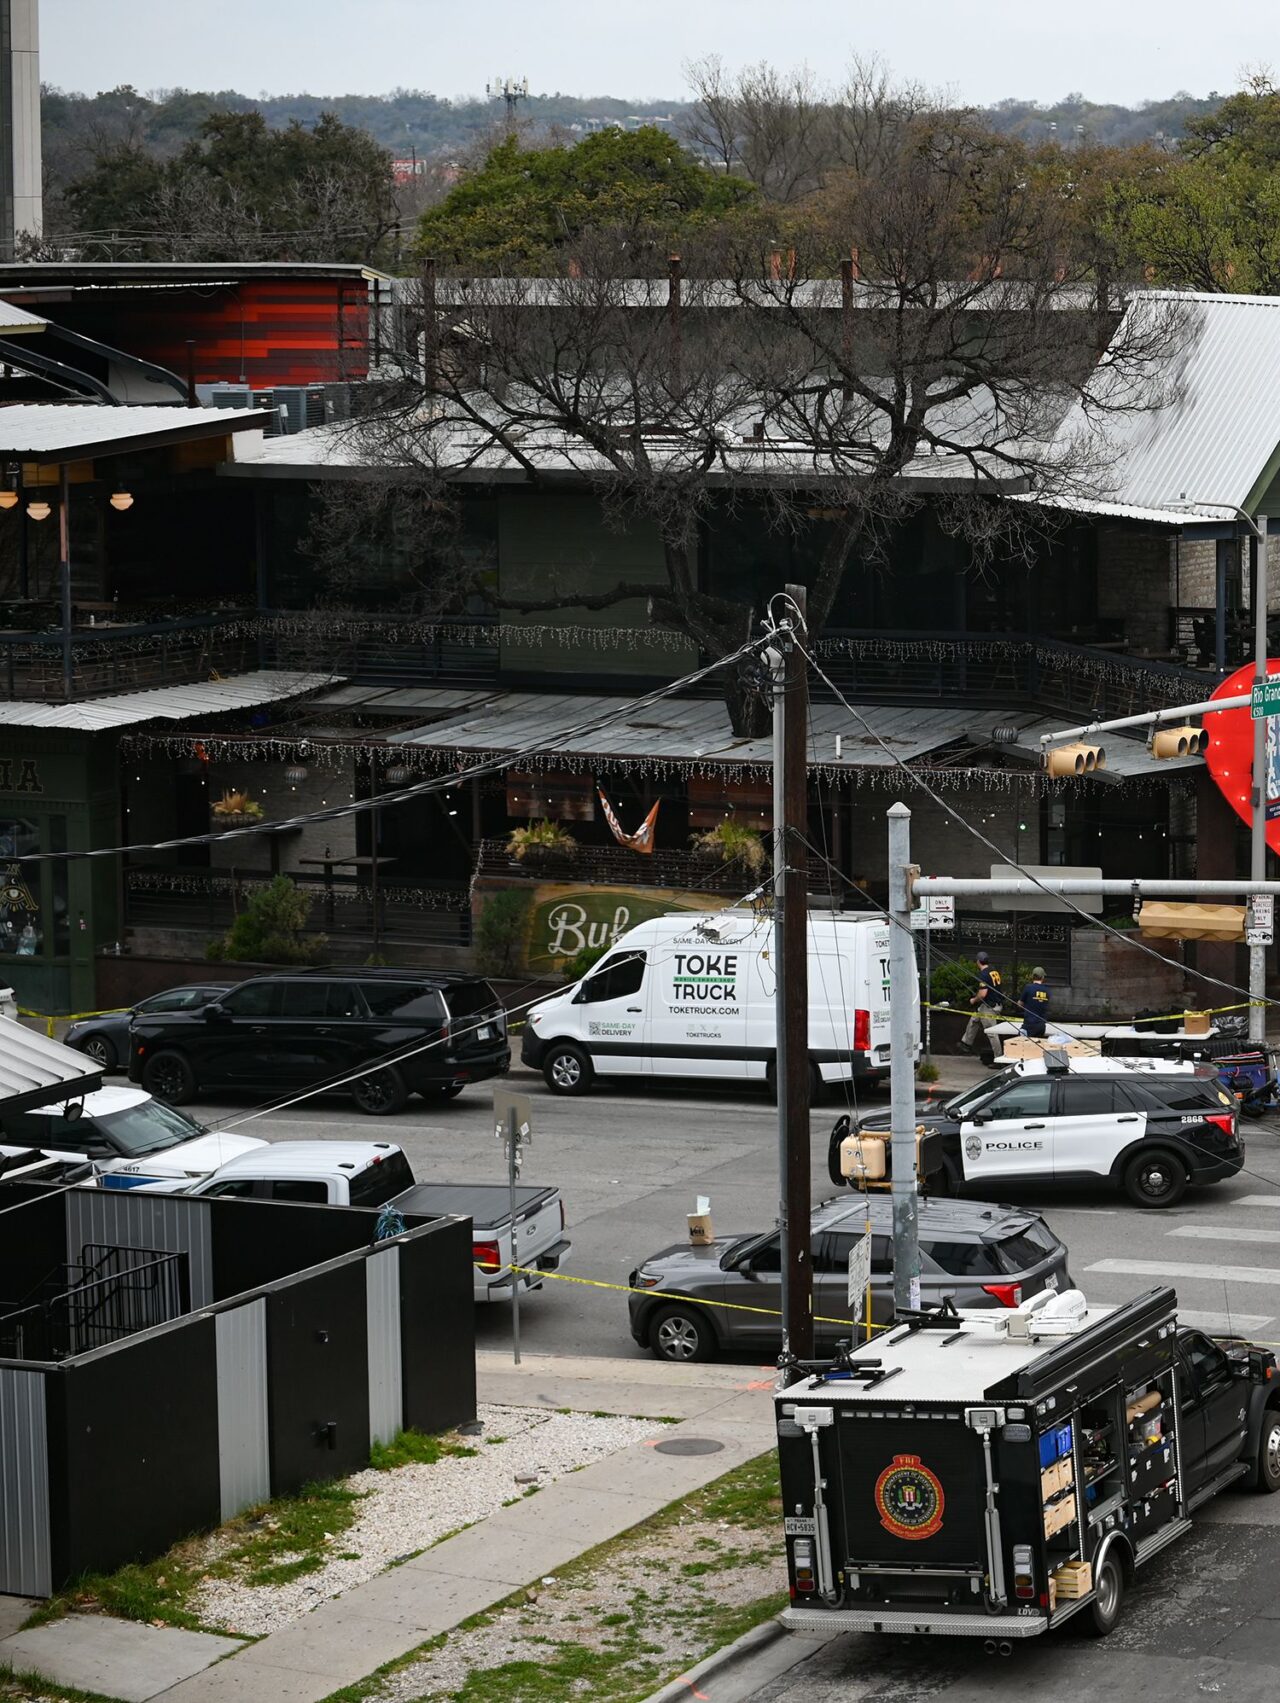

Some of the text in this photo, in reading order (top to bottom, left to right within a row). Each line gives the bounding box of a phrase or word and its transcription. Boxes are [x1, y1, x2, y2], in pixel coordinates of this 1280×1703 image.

[1254, 687, 1264, 704] Rio
[674, 954, 738, 976] TOKE
[673, 984, 736, 1000] TRUCK
[669, 1006, 740, 1015] TOKETRUCK.COM
[1181, 1115, 1204, 1124] 2868
[986, 1141, 1044, 1150] POLICE
